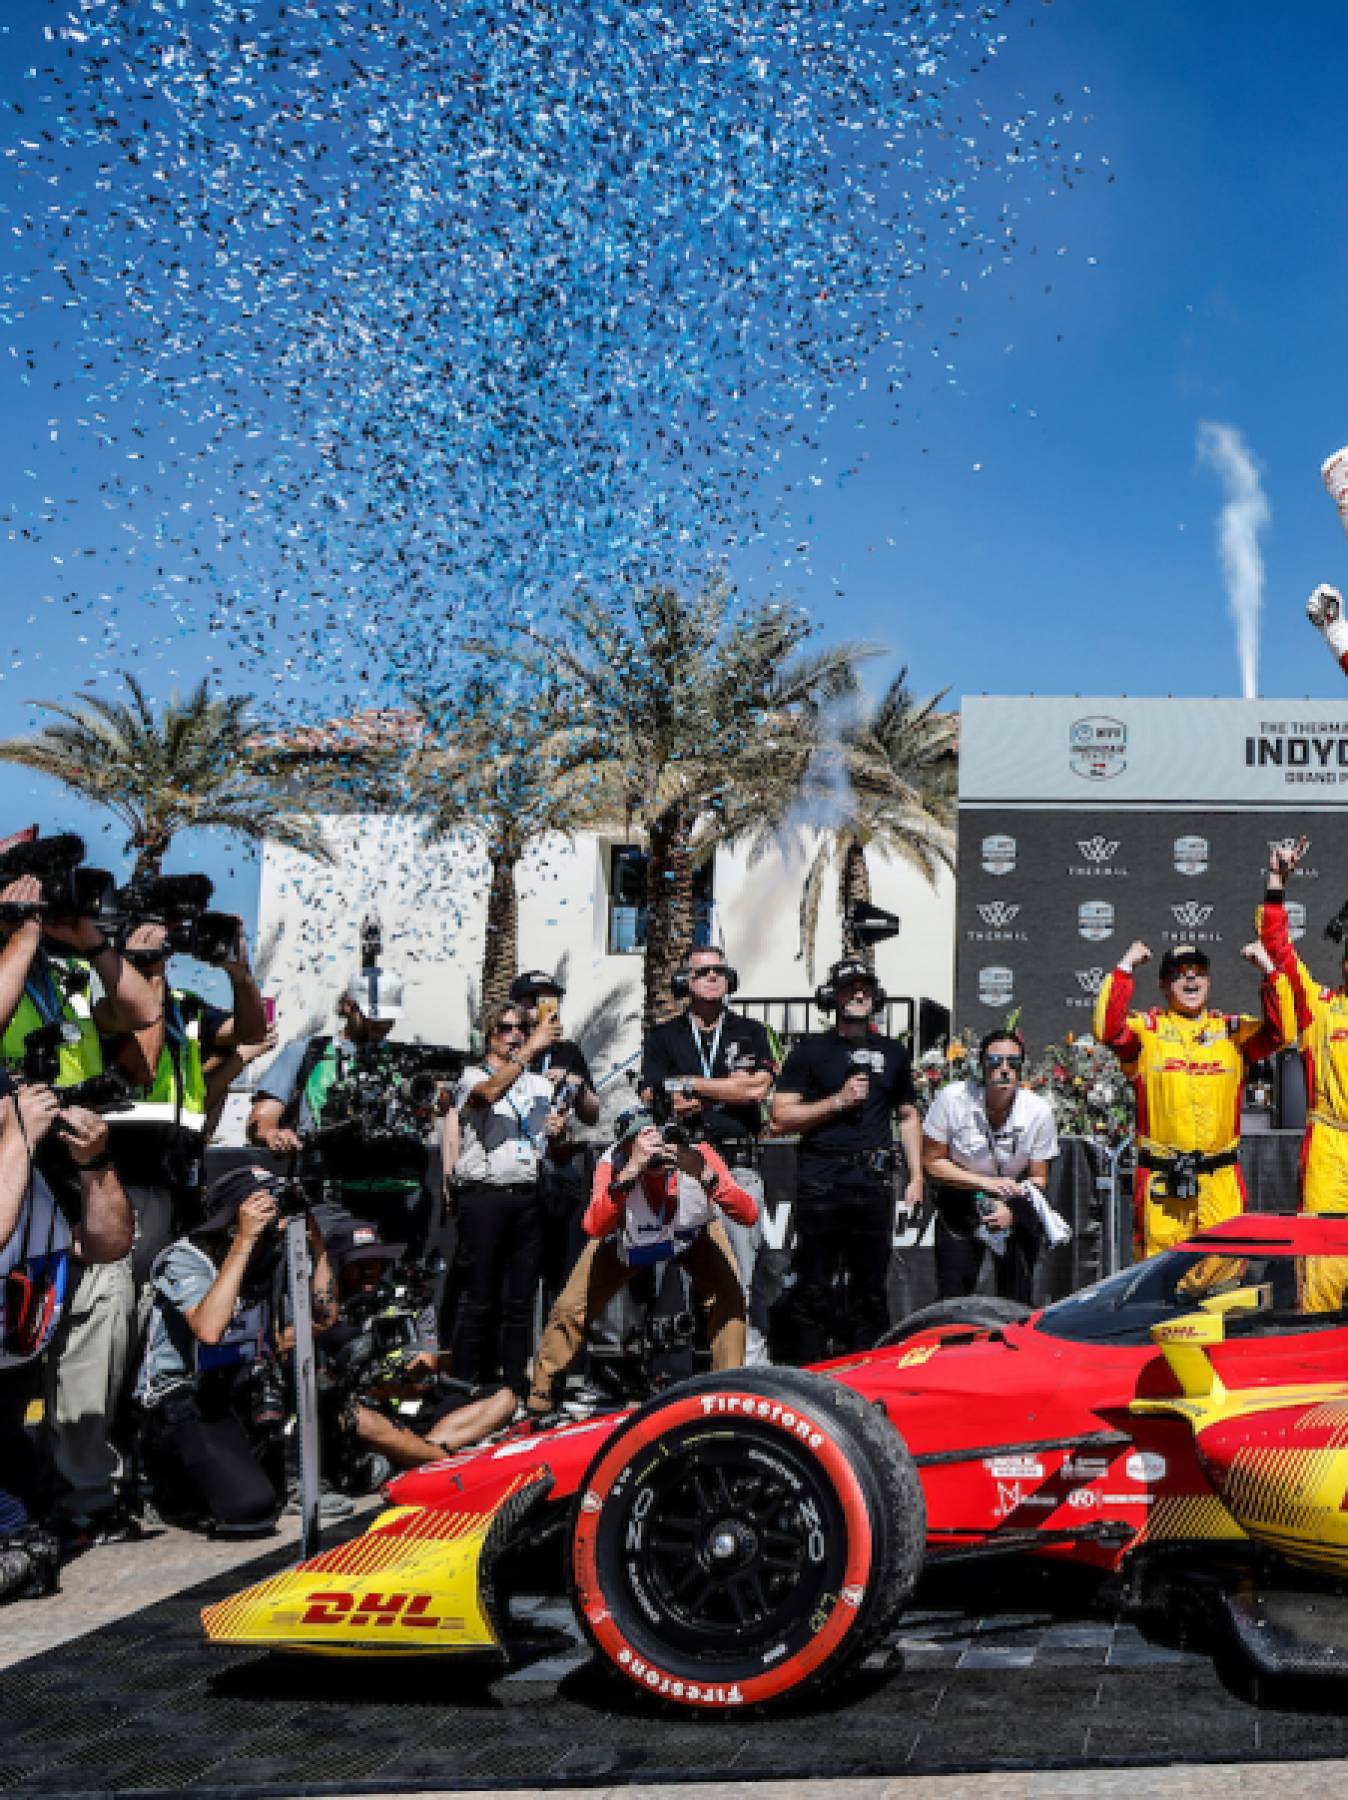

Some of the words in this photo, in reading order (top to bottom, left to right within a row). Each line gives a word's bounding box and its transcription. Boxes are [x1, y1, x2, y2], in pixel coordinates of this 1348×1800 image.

[1261, 721, 1286, 734] THE
[1285, 772, 1337, 784] GRAND
[700, 1394, 824, 1448] Firestone
[301, 1593, 441, 1627] DHL
[616, 1647, 744, 1705] Firestone
